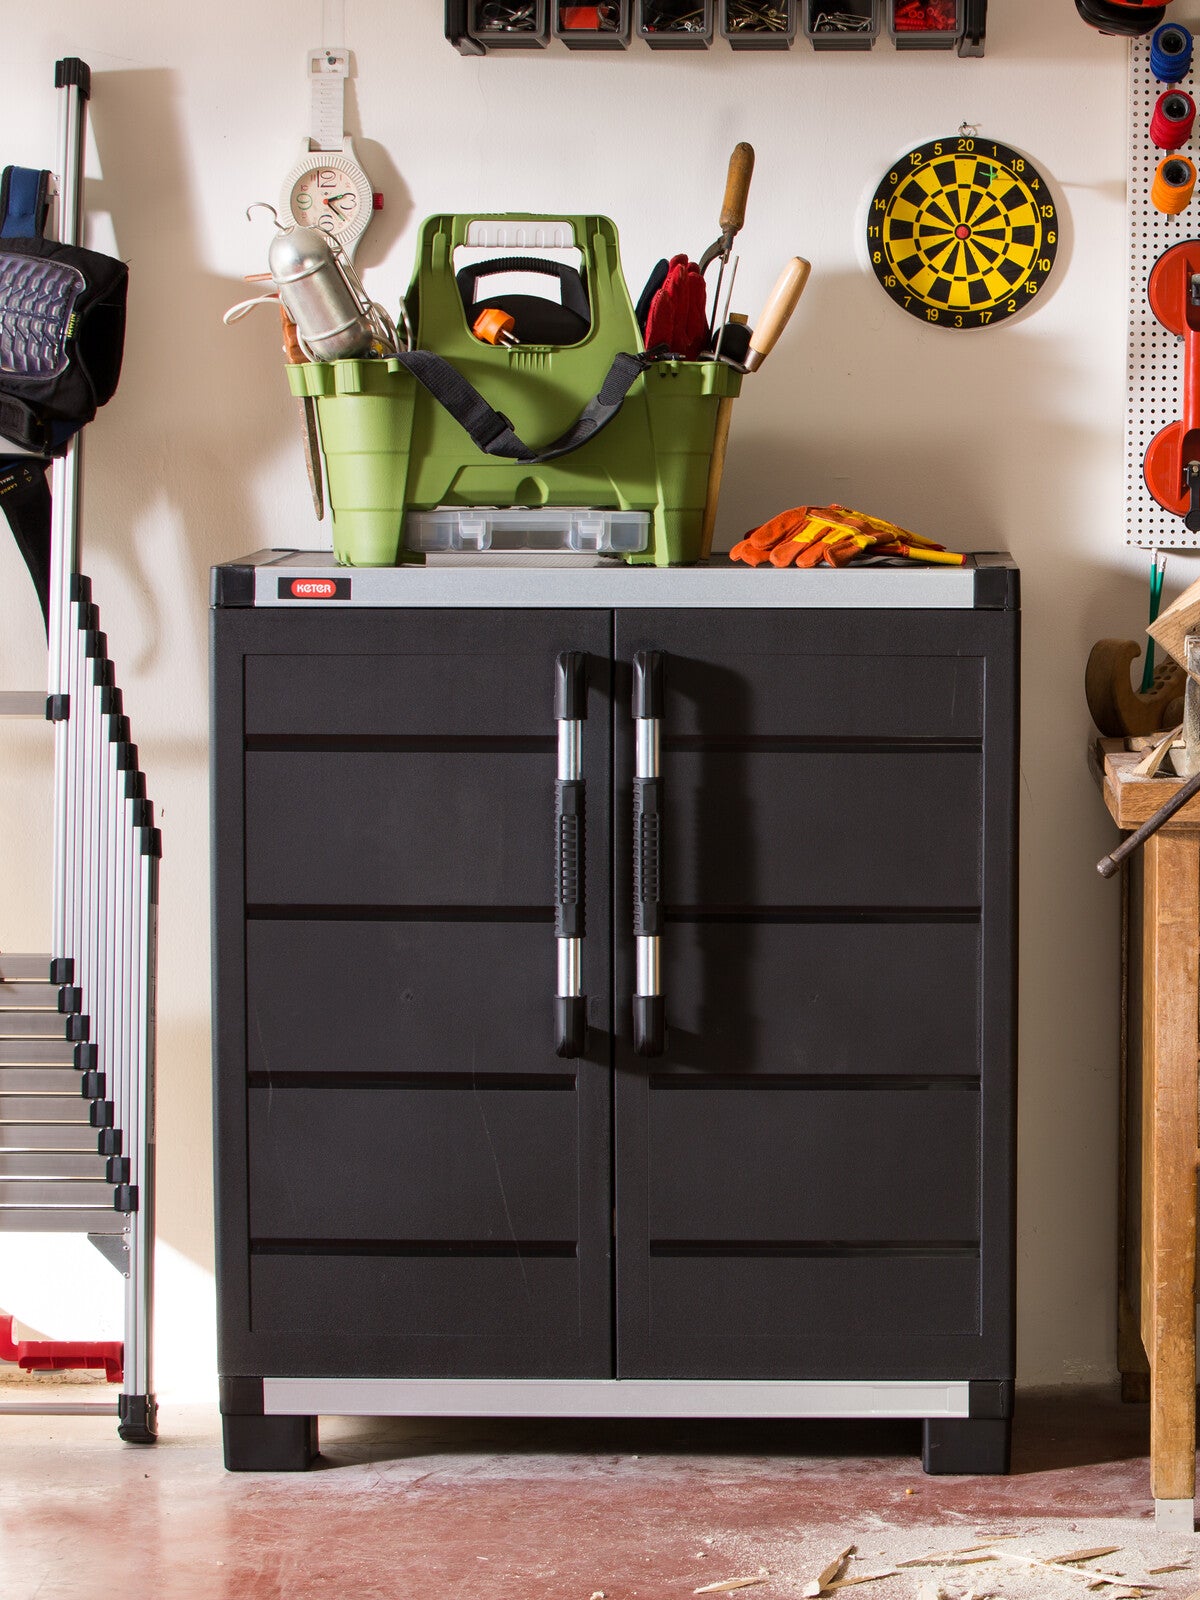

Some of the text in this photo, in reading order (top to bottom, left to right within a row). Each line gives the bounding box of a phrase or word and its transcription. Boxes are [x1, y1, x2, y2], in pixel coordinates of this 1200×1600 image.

[934, 143, 942, 155] 5
[957, 140, 975, 152] 20
[992, 145, 997, 157] 1
[909, 153, 922, 165] 12
[1011, 159, 1025, 172] 18
[316, 170, 336, 188] 12
[890, 172, 898, 184] 9
[1030, 178, 1040, 190] 4
[296, 192, 313, 211] 9
[340, 193, 357, 210] 3
[874, 199, 886, 211] 14
[1040, 205, 1054, 218] 13
[868, 226, 879, 237] 11
[1047, 231, 1056, 244] 6
[873, 251, 881, 263] 8
[1038, 259, 1051, 272] 10
[883, 275, 896, 287] 16
[1024, 282, 1037, 294] 15
[904, 296, 913, 308] 7
[1008, 299, 1016, 312] 2
[925, 308, 939, 321] 19
[979, 311, 992, 324] 17
[66, 313, 76, 338] IRWIN
[954, 315, 963, 328] 3
[296, 583, 332, 594] KETER
